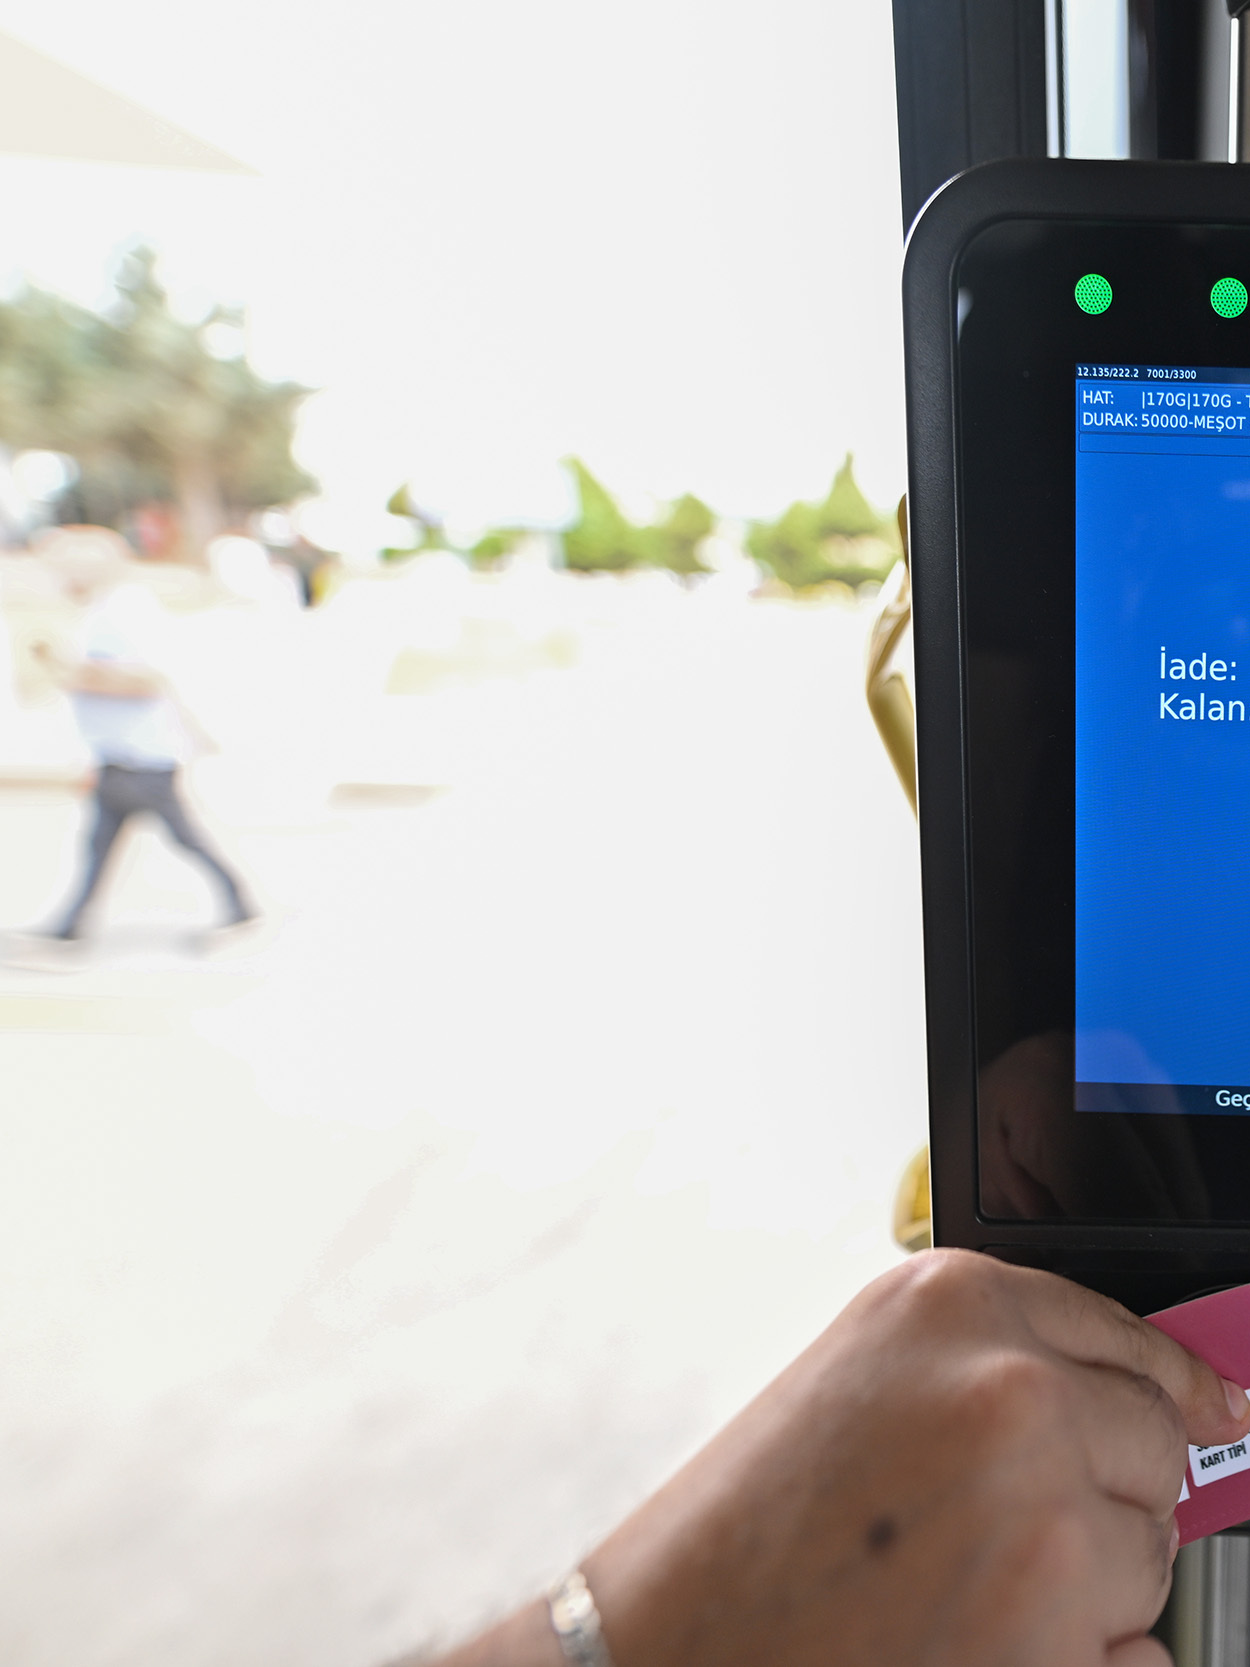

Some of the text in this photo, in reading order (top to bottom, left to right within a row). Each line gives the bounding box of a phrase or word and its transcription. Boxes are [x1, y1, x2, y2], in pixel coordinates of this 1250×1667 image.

[1077, 366, 1197, 380] 12.135/222.2 7001/3300
[1082, 390, 1115, 405] HAT:
[1082, 412, 1138, 428] DURAK:
[1141, 413, 1246, 433] 50000-MEŞOT
[1160, 646, 1237, 681] İade:
[1200, 1450, 1226, 1470] KART
[1226, 1441, 1247, 1460] TİPİ
